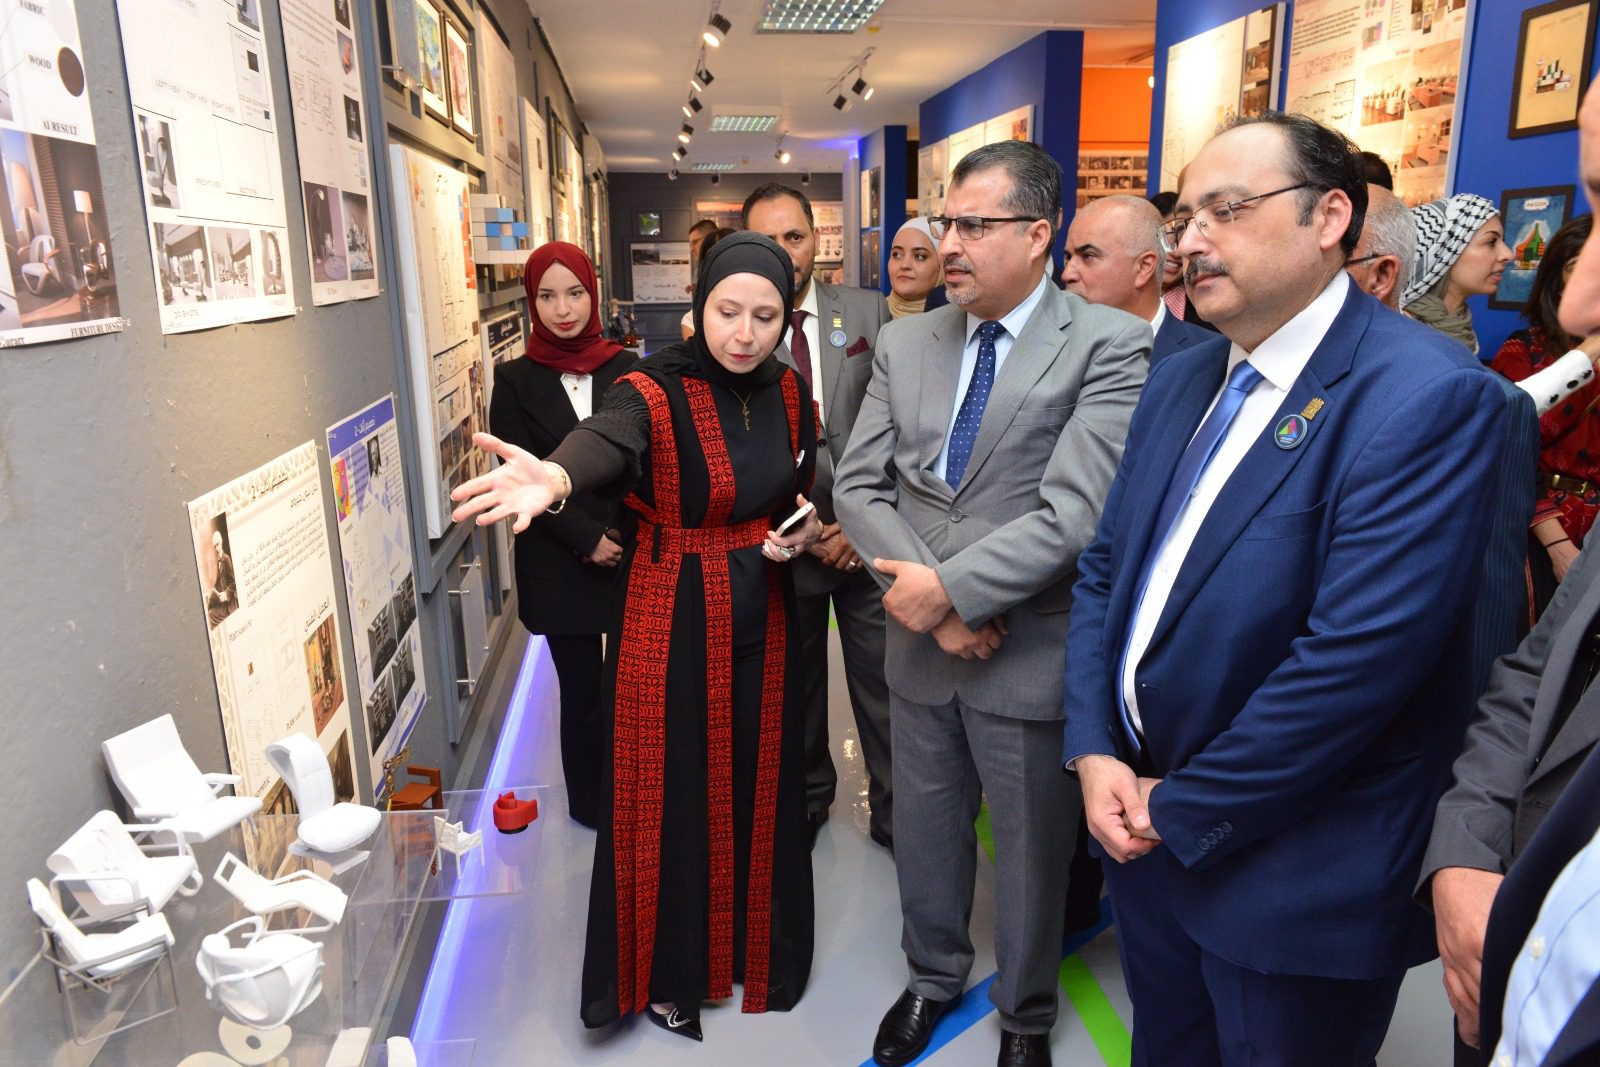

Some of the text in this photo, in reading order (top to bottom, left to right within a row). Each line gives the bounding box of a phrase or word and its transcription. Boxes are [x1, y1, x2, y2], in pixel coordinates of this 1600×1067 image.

[27, 53, 52, 70] WOOD
[42, 121, 79, 136] AI RESULT
[70, 324, 104, 337] FURNITURE
